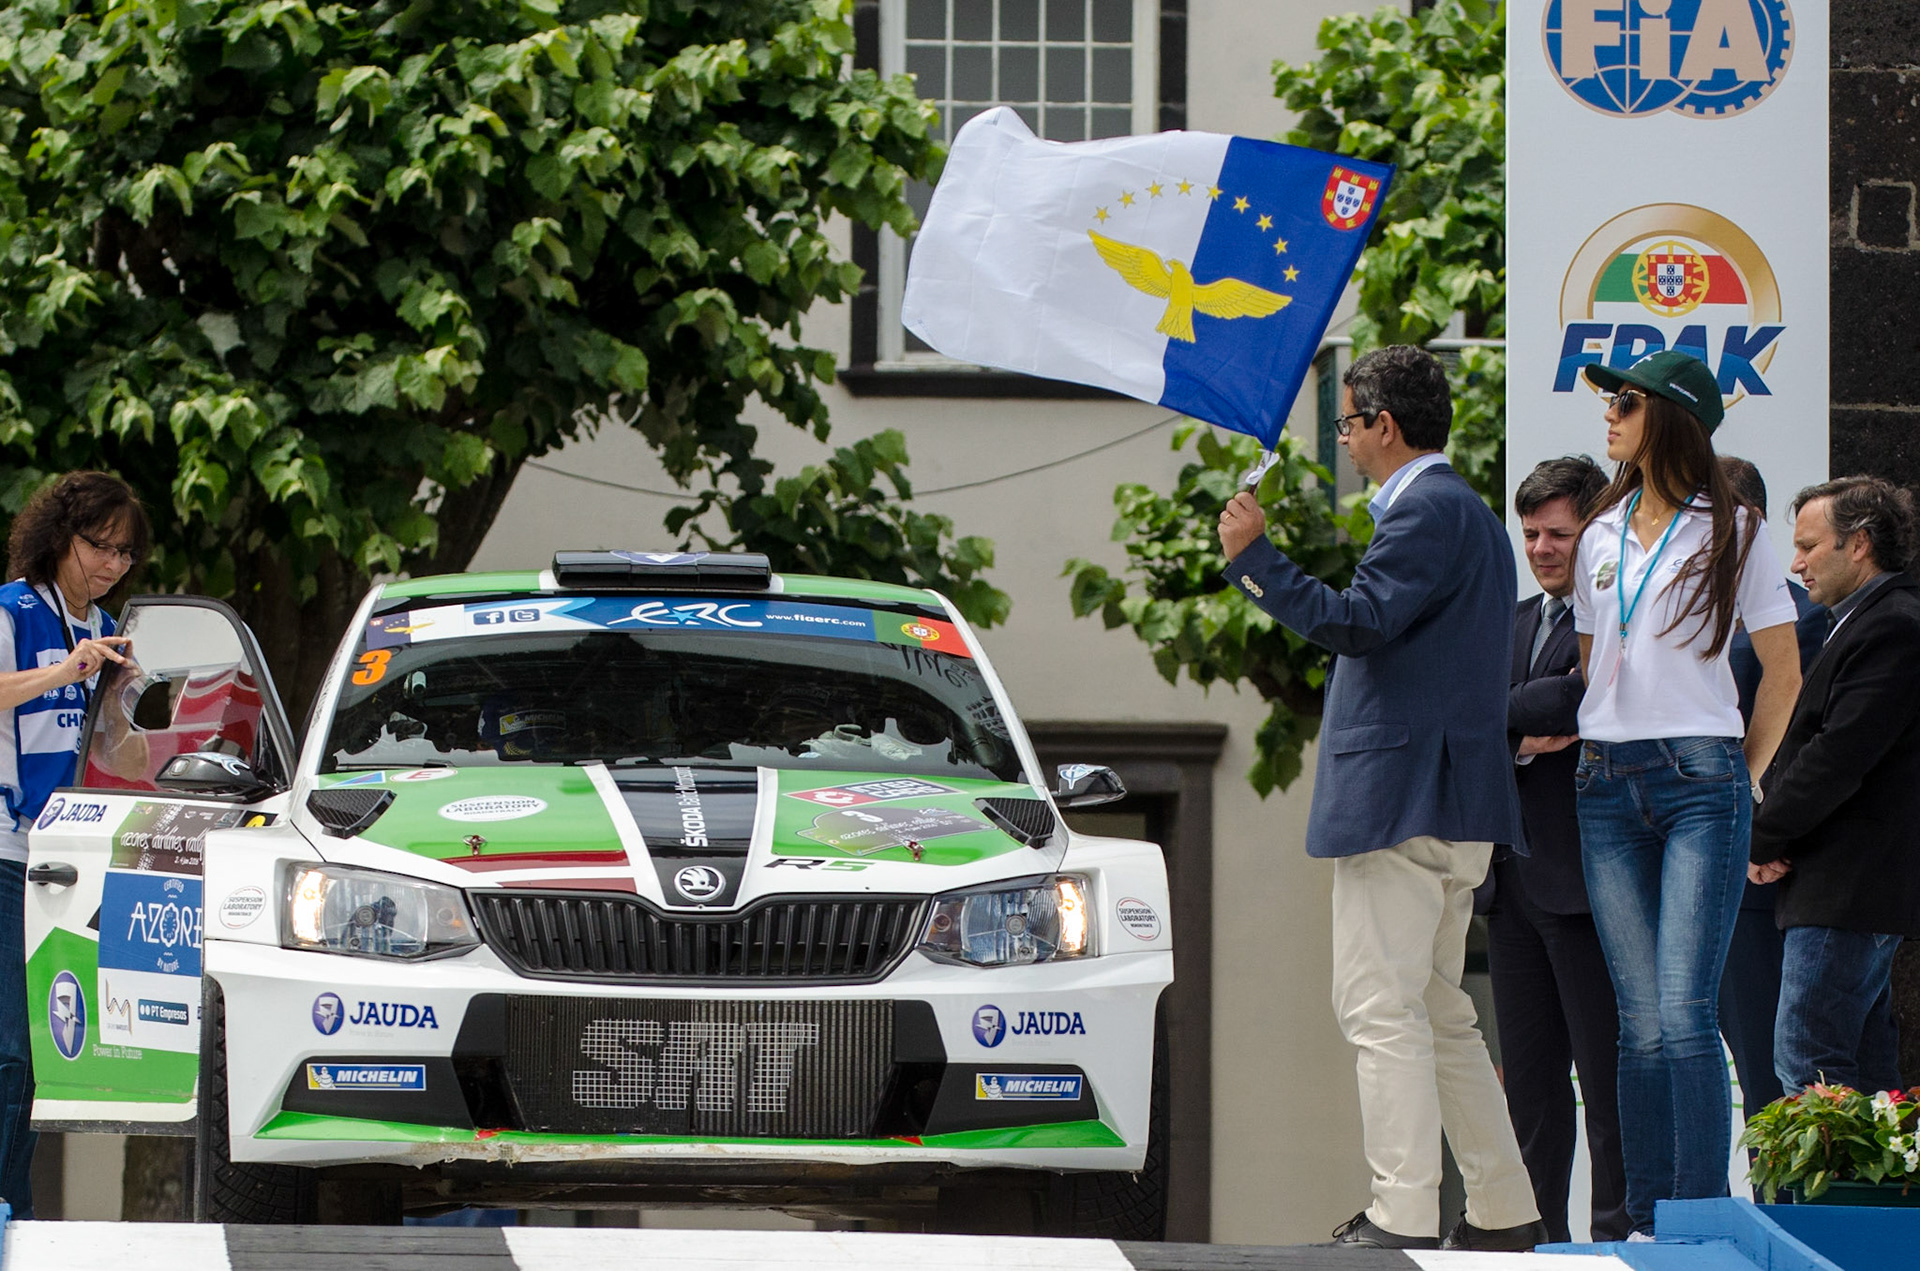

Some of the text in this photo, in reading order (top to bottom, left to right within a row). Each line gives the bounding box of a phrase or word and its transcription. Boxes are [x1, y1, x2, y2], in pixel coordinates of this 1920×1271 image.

[765, 614, 866, 627] www.fiaerc.com
[352, 650, 392, 685] 3
[845, 780, 925, 793] INTER
[868, 786, 945, 798] CARS
[446, 803, 539, 813] LABORATORY
[451, 800, 535, 808] SUSPENSION
[60, 803, 107, 823] JAUDA
[680, 806, 708, 847] ŠKODA
[764, 858, 875, 872] R5
[151, 1004, 159, 1017] PT
[350, 1002, 439, 1029] JAUDA
[1012, 1012, 1086, 1035] JAUDA
[572, 1019, 819, 1112] SRT
[336, 1069, 419, 1083] MICHELIN
[1004, 1079, 1077, 1094] MICHELIN
